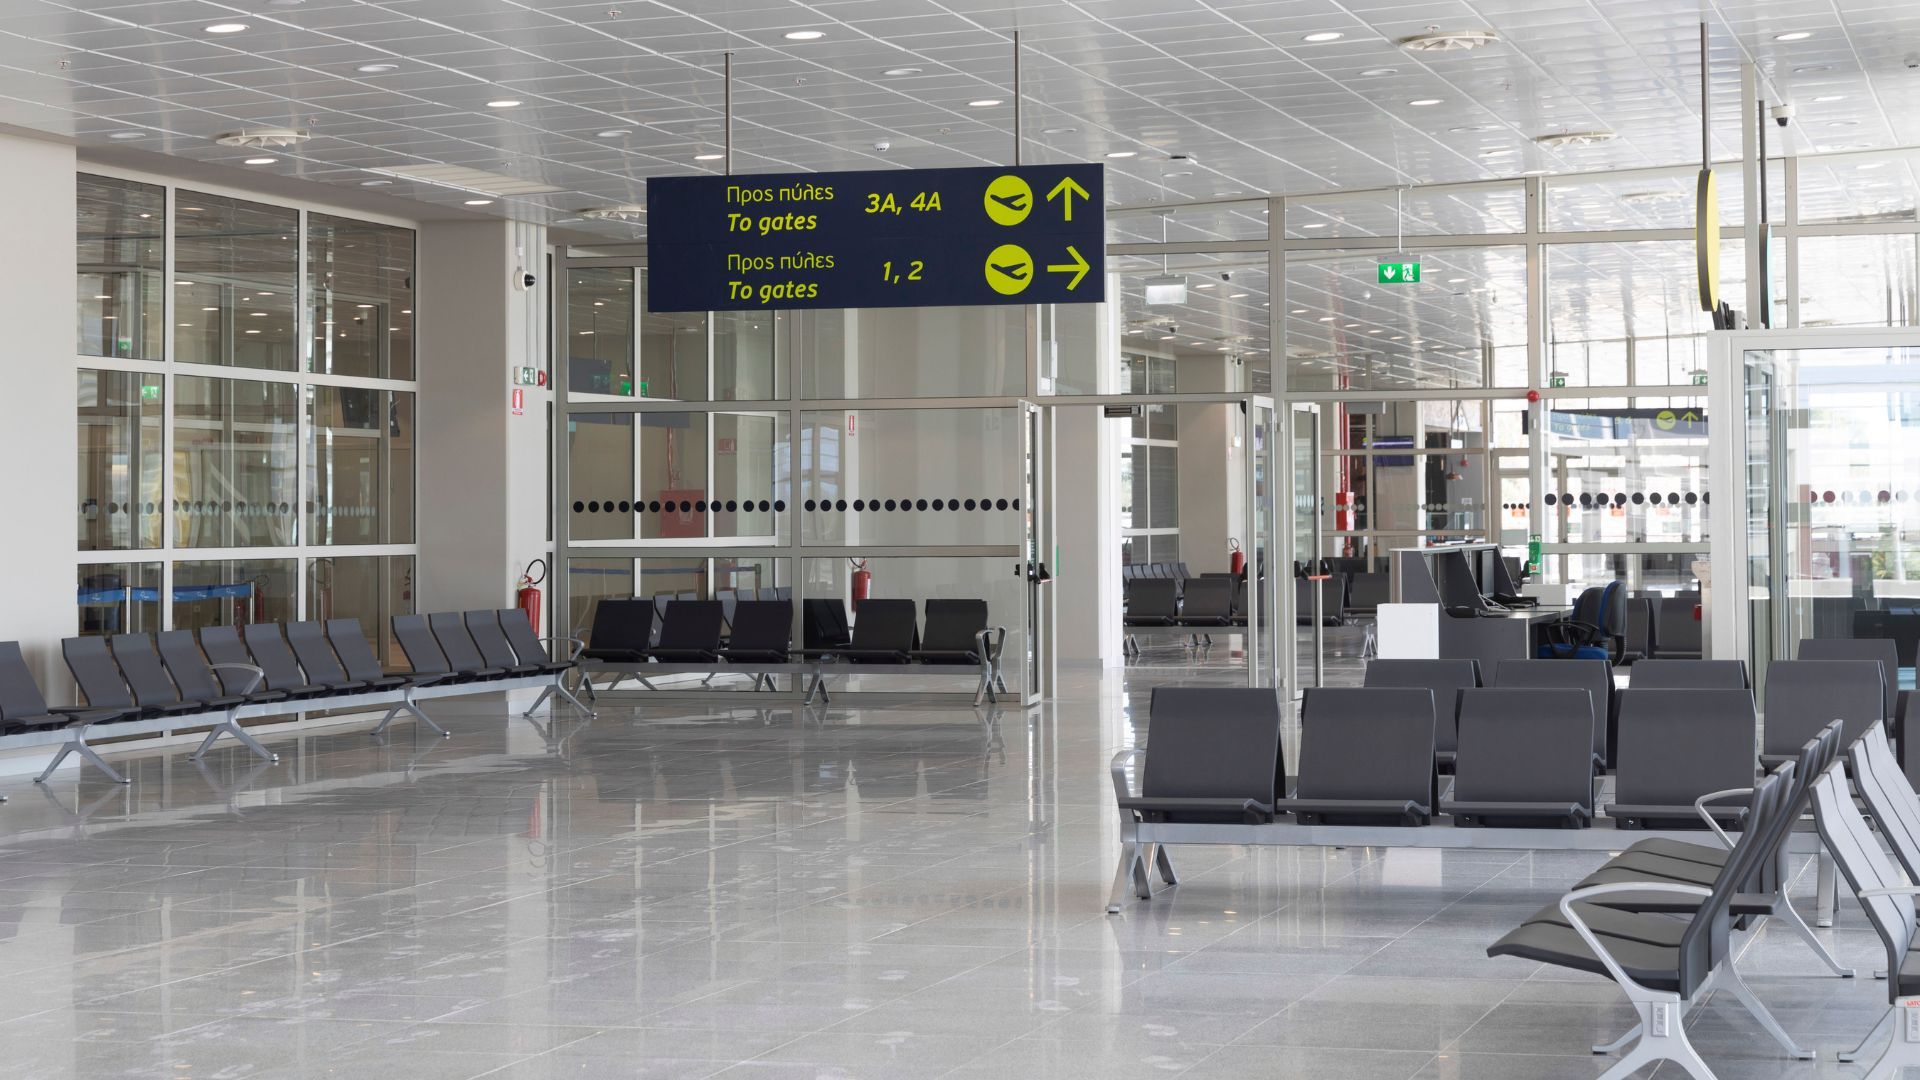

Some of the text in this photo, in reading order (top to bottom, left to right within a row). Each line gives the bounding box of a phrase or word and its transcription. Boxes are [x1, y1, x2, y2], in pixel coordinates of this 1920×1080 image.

[727, 182, 834, 206] Προς πύλες
[864, 191, 942, 216] 3A, 4A
[727, 212, 817, 236] To gates
[727, 251, 835, 274] Προς πύλες
[882, 260, 924, 284] 1, 2
[728, 280, 818, 304] To gates
